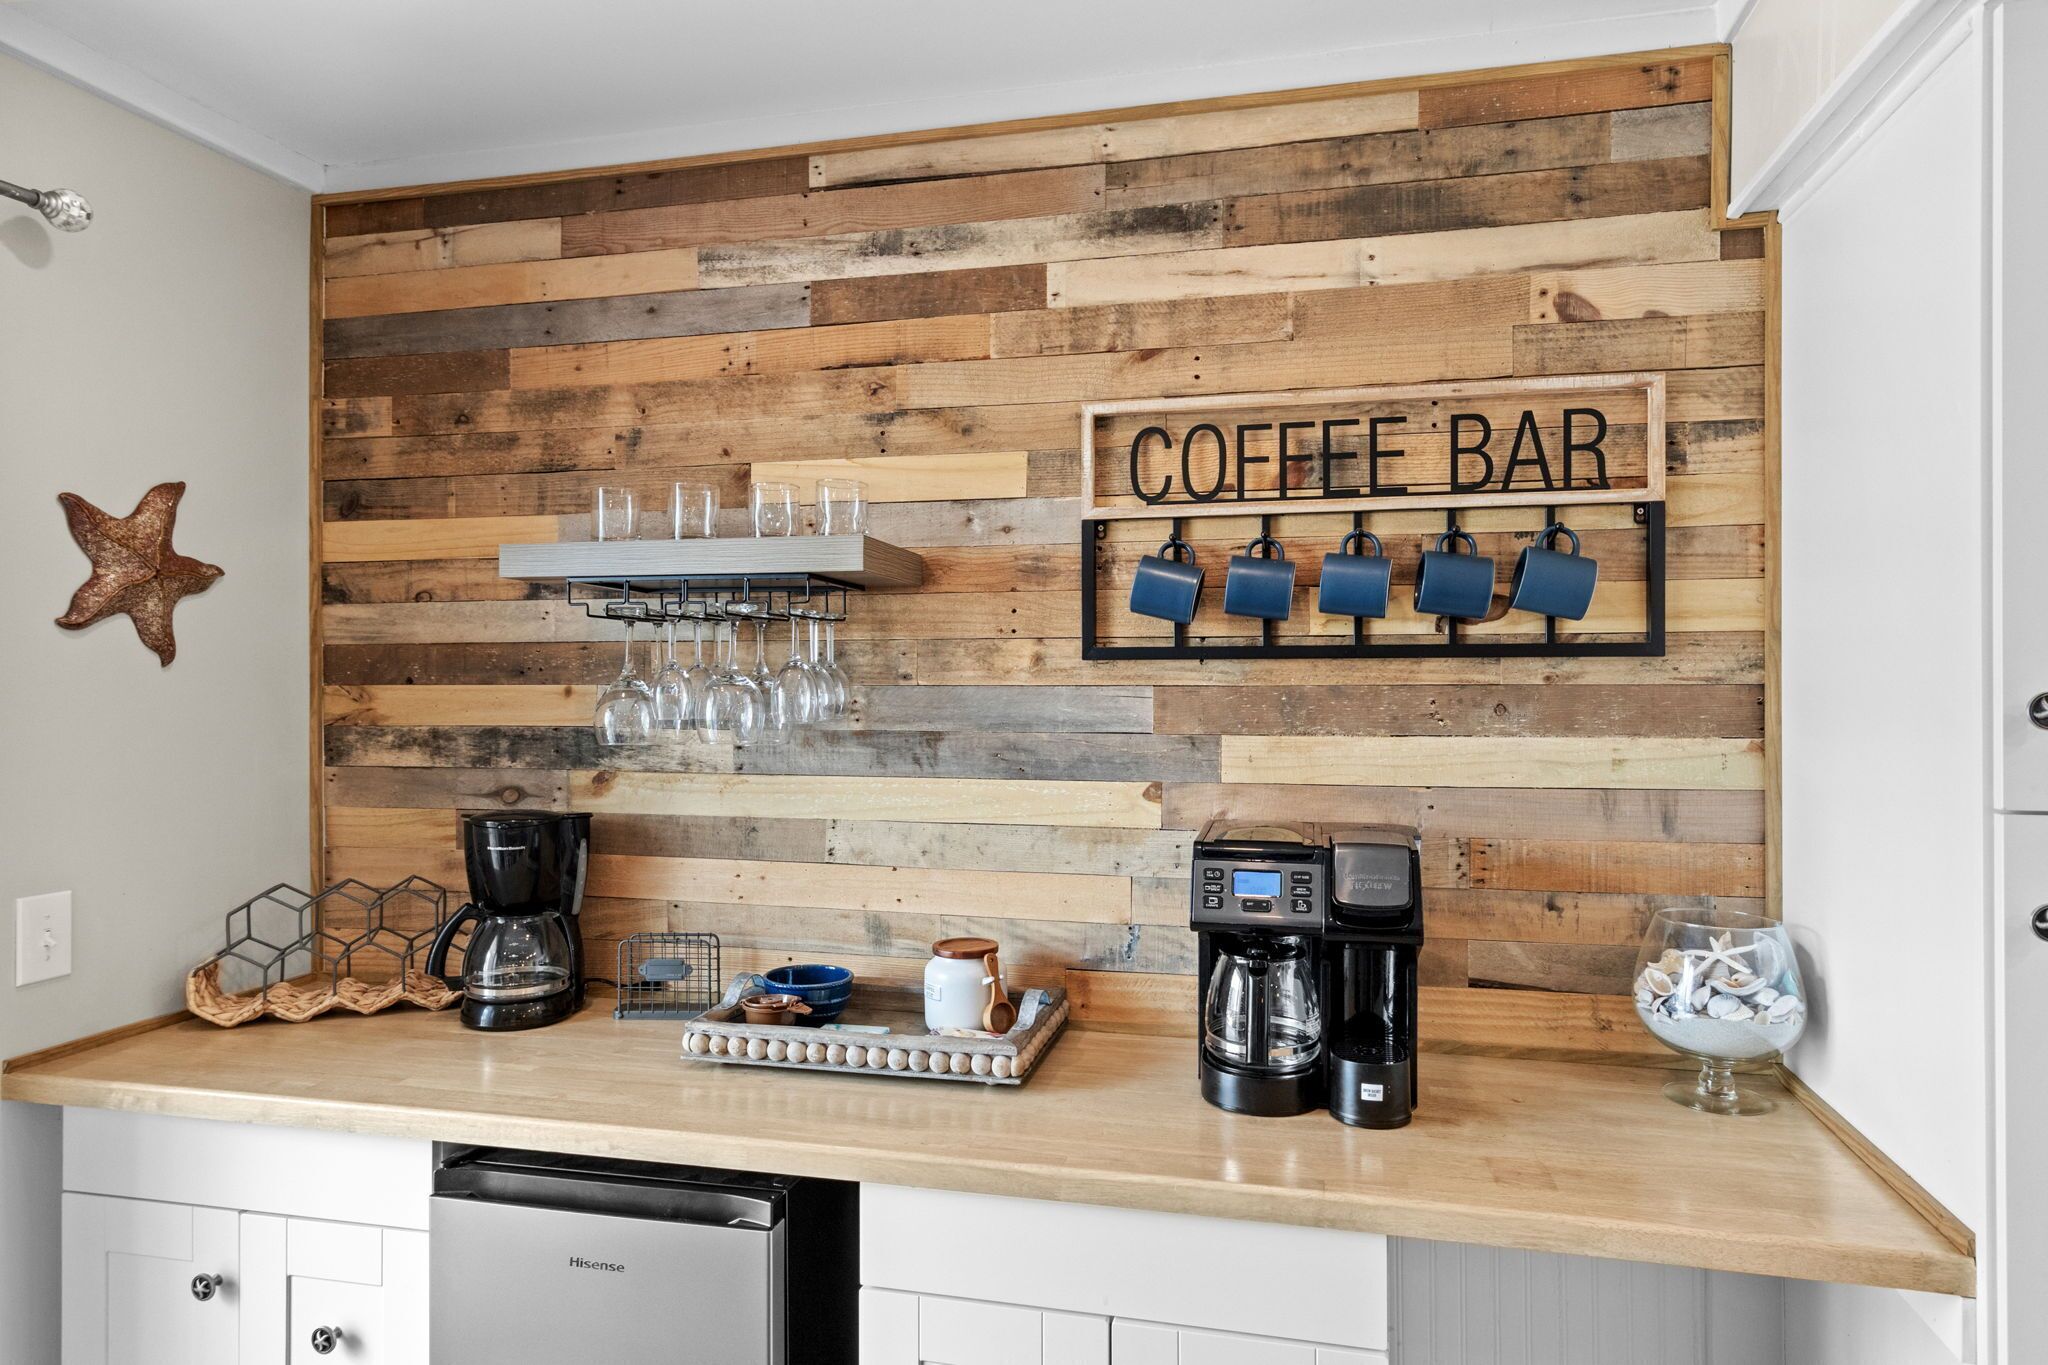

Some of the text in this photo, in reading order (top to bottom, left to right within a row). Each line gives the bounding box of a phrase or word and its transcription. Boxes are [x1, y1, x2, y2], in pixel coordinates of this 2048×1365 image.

[1130, 407, 1611, 501] COFFEE BAR
[569, 1256, 625, 1273] Hisense
